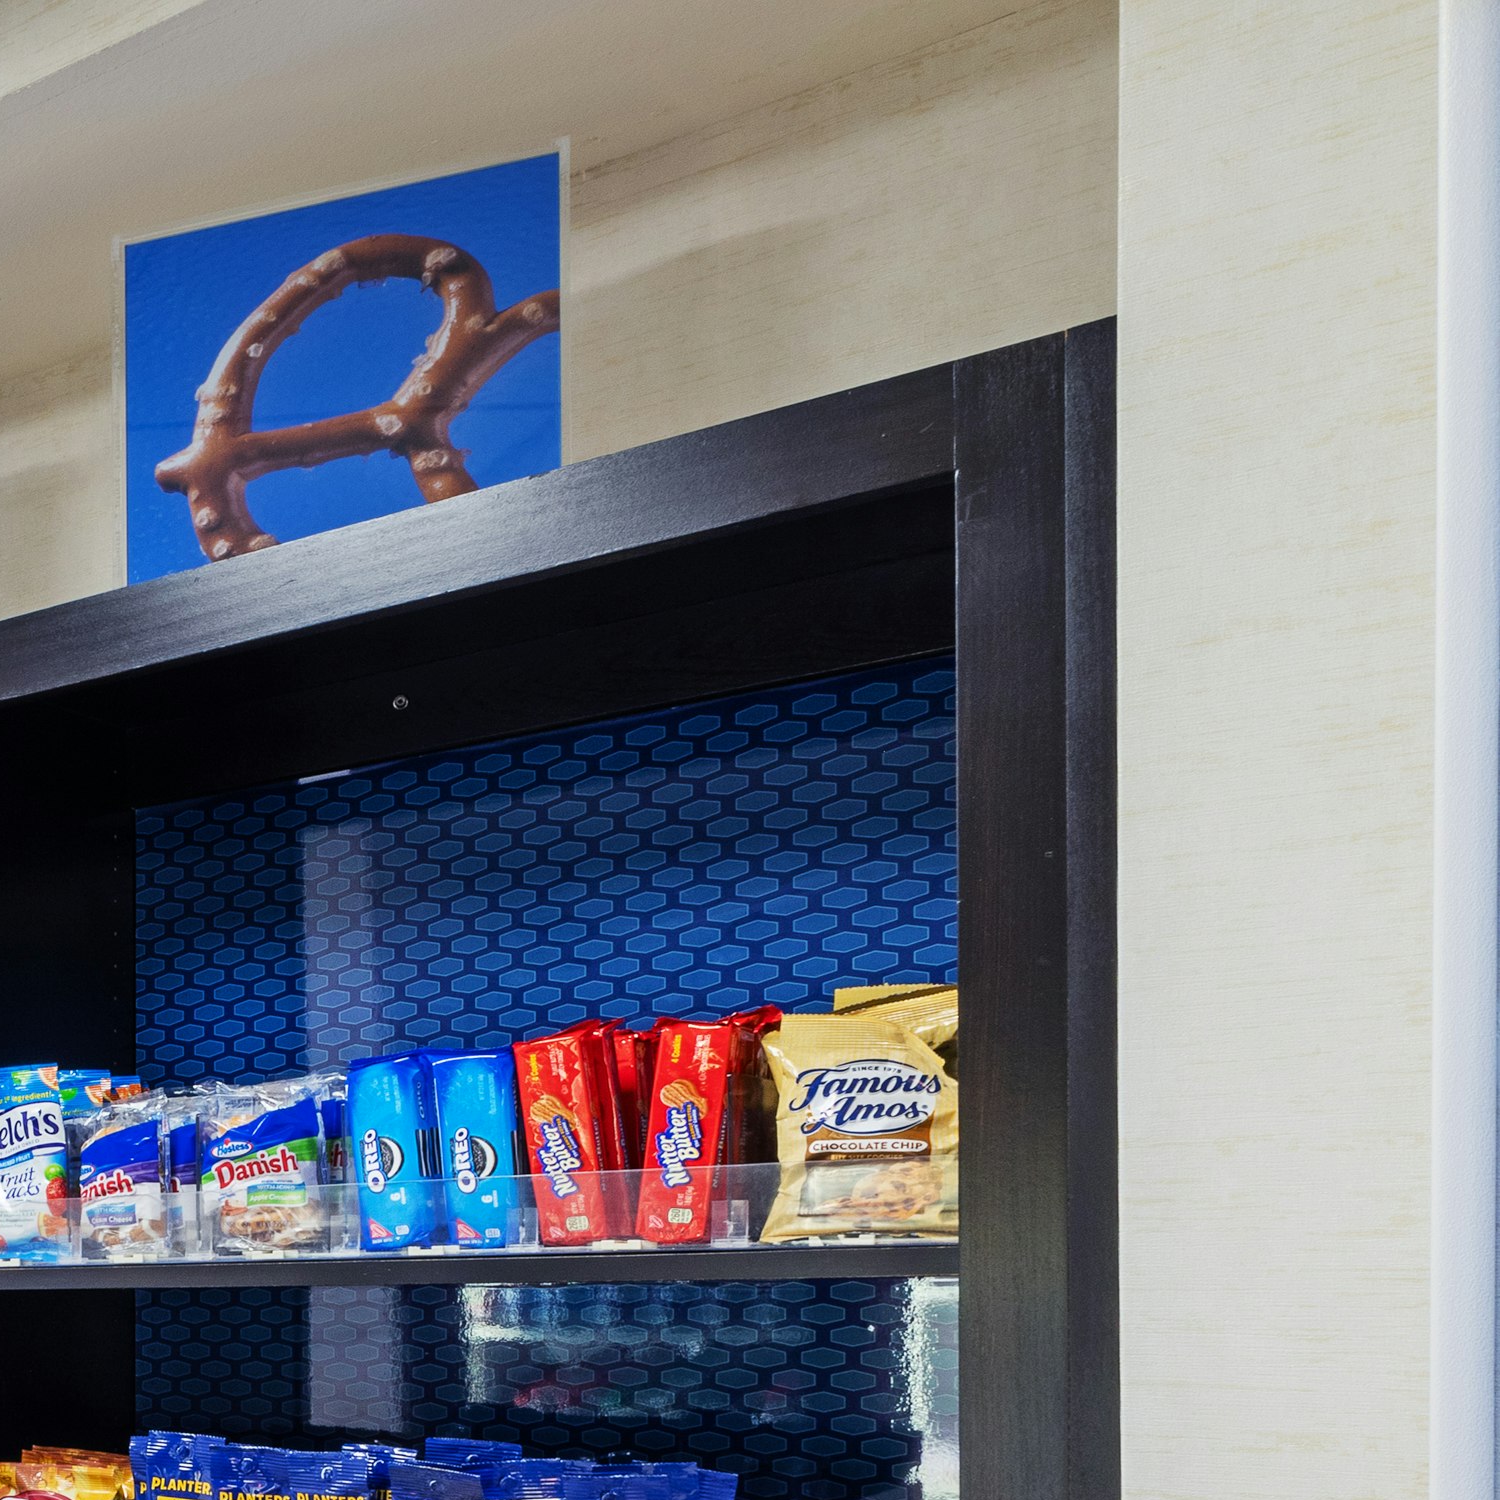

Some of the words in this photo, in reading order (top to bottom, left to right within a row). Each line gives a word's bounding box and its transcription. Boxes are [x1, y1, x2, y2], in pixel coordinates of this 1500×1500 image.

[671, 1034, 682, 1058] Cookies
[851, 1065, 879, 1073] SINCE
[12, 1091, 53, 1102] ingredient!
[789, 1068, 942, 1112] Famous
[671, 1109, 700, 1160] Butter
[800, 1096, 929, 1135] Amos
[15, 1153, 31, 1163] FRUIT
[216, 1142, 250, 1156] Hostess
[364, 1129, 386, 1194] OREO
[454, 1127, 478, 1194] OREO
[544, 1121, 581, 1172] Butter
[660, 1134, 691, 1187] Nutter
[813, 1141, 888, 1151] CHOCOLATE
[891, 1141, 923, 1150] CHIP
[0, 1166, 35, 1188] Fruit
[214, 1149, 299, 1190] Danish
[539, 1148, 578, 1197] Nutter
